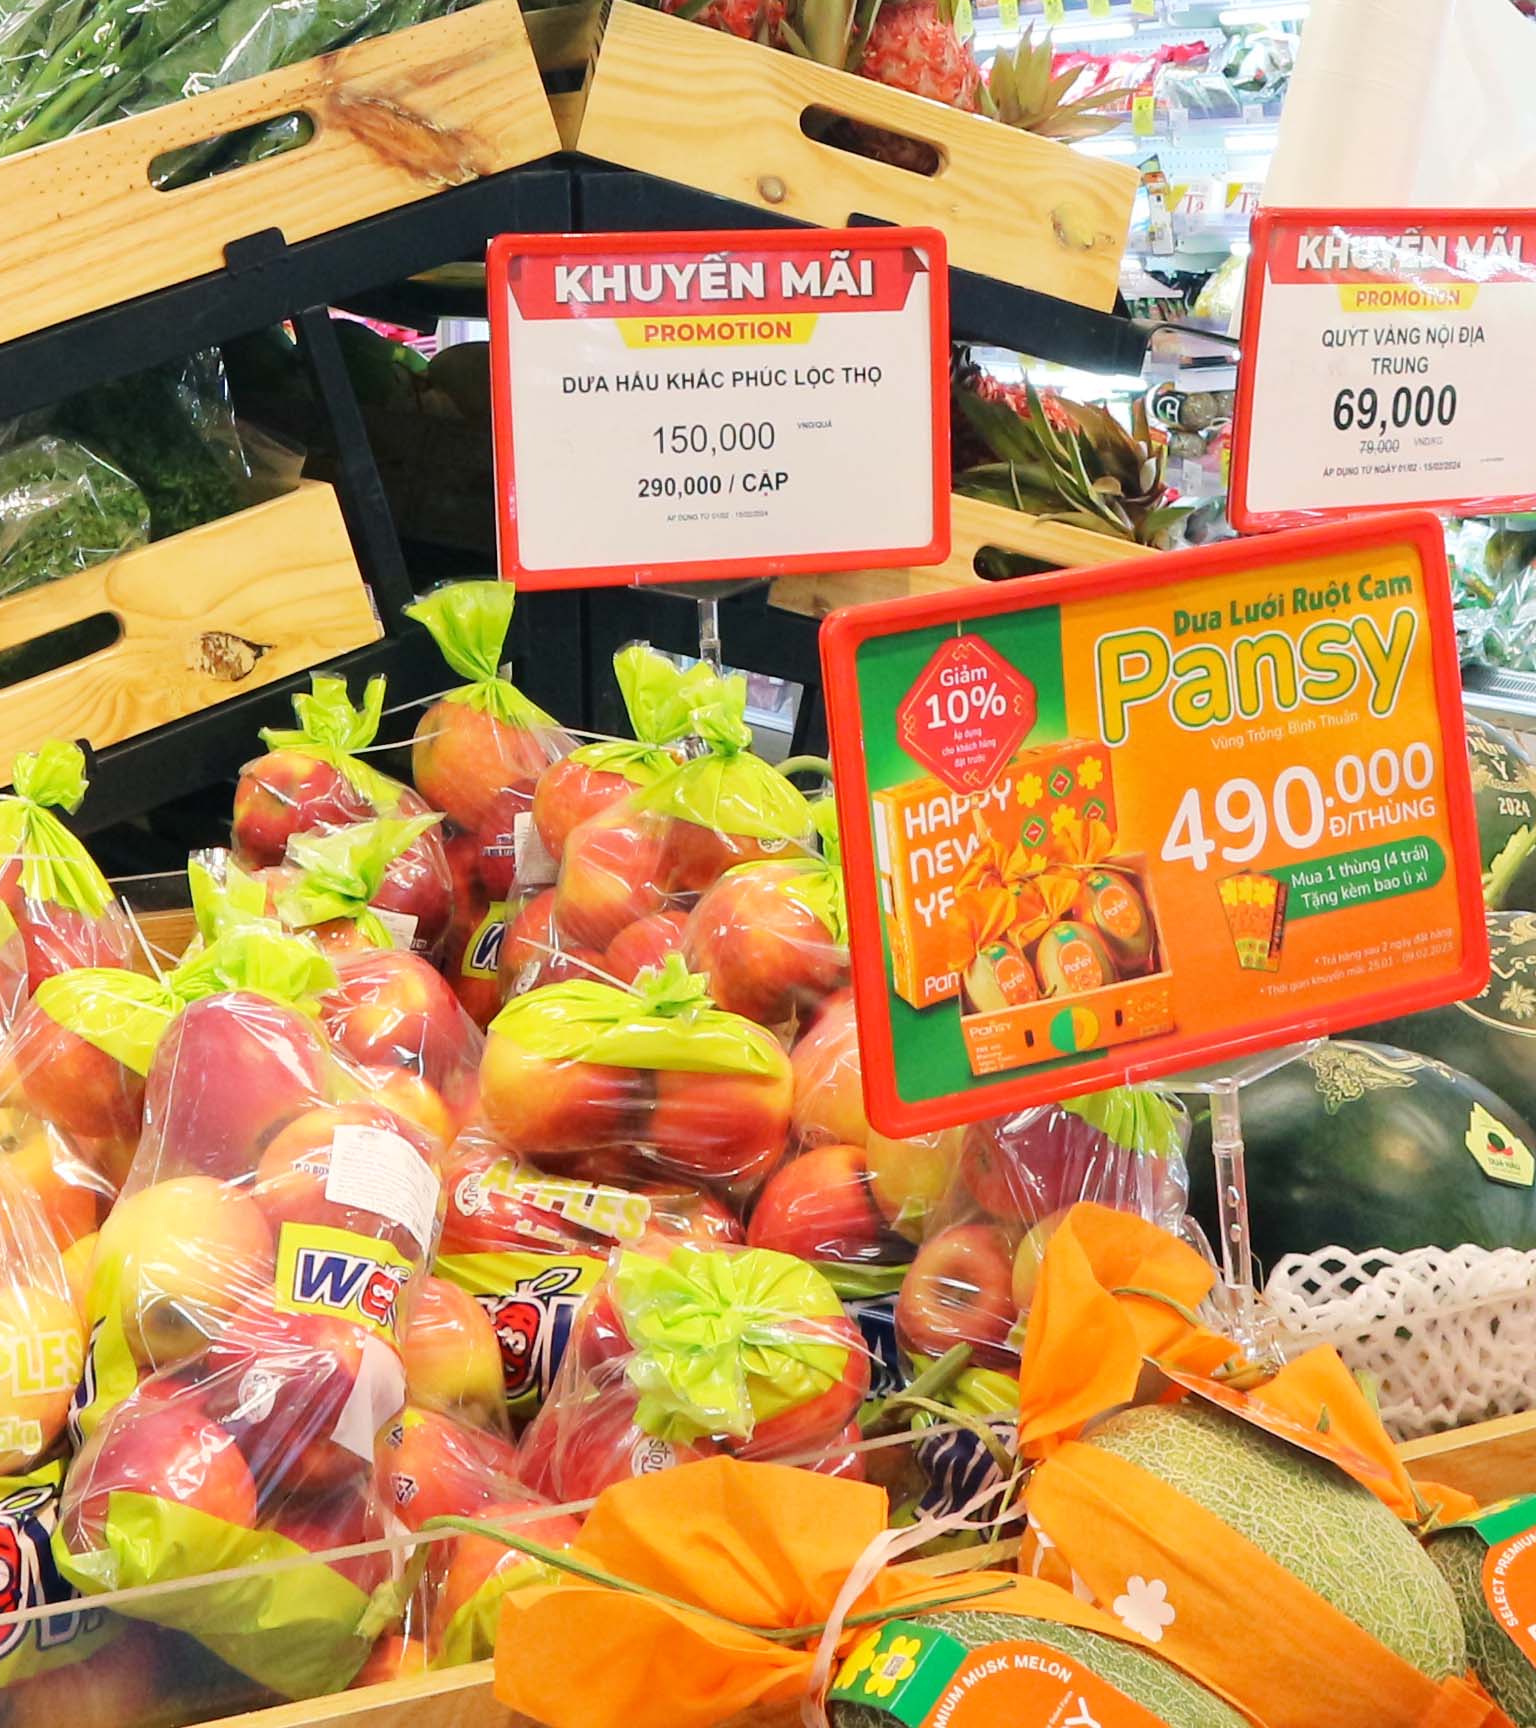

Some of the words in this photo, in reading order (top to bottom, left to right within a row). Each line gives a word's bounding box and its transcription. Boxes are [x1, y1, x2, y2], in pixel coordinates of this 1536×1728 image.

[555, 251, 765, 303] KHUYẾN
[782, 249, 874, 298] MÃI
[644, 320, 792, 343] PROMOTION
[1322, 326, 1369, 348] QUÝT
[1374, 325, 1420, 346] VÀNG
[1426, 325, 1455, 348] NỘI
[1459, 325, 1485, 347] ĐỊA
[562, 373, 608, 394] DƯA
[732, 365, 787, 388] PHÚC
[794, 365, 834, 390] LỘC
[843, 366, 882, 388] THỌ
[1371, 357, 1429, 375] TRUNG
[1333, 384, 1457, 436] 69,000
[652, 421, 775, 456] 150,000
[638, 475, 721, 499] 290,000
[1292, 582, 1351, 614] Ruột
[1359, 574, 1413, 602] Cam
[940, 664, 987, 687] Giảm
[1094, 606, 1417, 747] Pansy
[925, 682, 1007, 729] 10%
[1211, 733, 1245, 750] Vùng
[1287, 718, 1316, 735] Bình
[1329, 794, 1436, 839] Đ/THÙNG
[1497, 797, 1532, 818] 2024
[1291, 871, 1323, 888] Mua
[1327, 866, 1336, 880] 1
[1339, 858, 1381, 878] thùng
[1383, 852, 1398, 870] (4
[1400, 844, 1430, 864] trái)
[1301, 892, 1339, 910] Tặng
[1341, 883, 1371, 900] kèm
[1373, 876, 1400, 892] bao
[1403, 871, 1413, 886] lì
[1415, 867, 1428, 883] xì
[1492, 1578, 1519, 1627] SELECT
[963, 1657, 1009, 1689] MUSK
[1014, 1654, 1072, 1683] MELON
